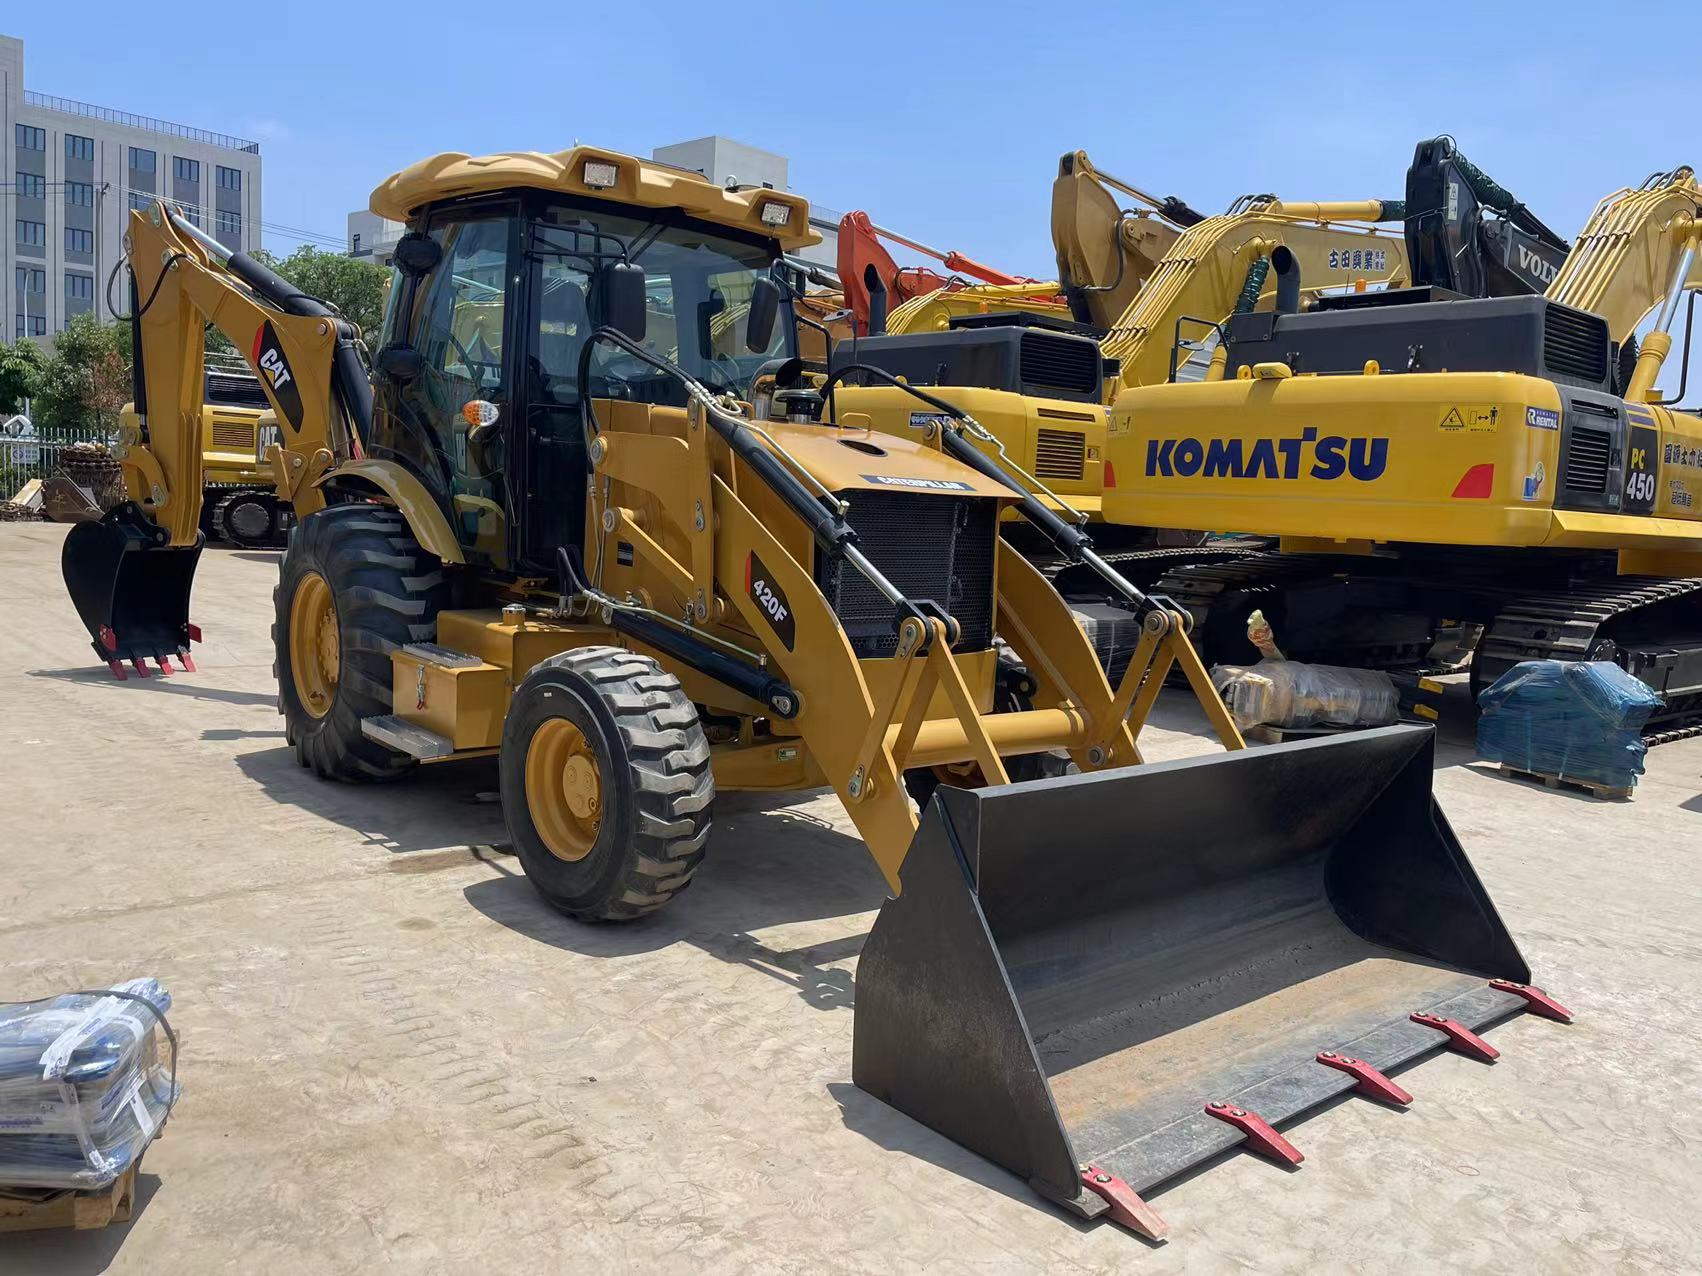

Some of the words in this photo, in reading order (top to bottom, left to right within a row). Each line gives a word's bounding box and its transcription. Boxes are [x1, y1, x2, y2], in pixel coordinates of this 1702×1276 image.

[260, 348, 291, 390] CAT
[1536, 416, 1558, 429] RENTAL
[260, 426, 278, 461] CAT
[1145, 426, 1390, 482] KOMATSU
[1630, 447, 1646, 470] PC
[876, 476, 966, 490] CATERPILLAR
[1626, 472, 1655, 501] 450
[753, 579, 788, 622] 420F
